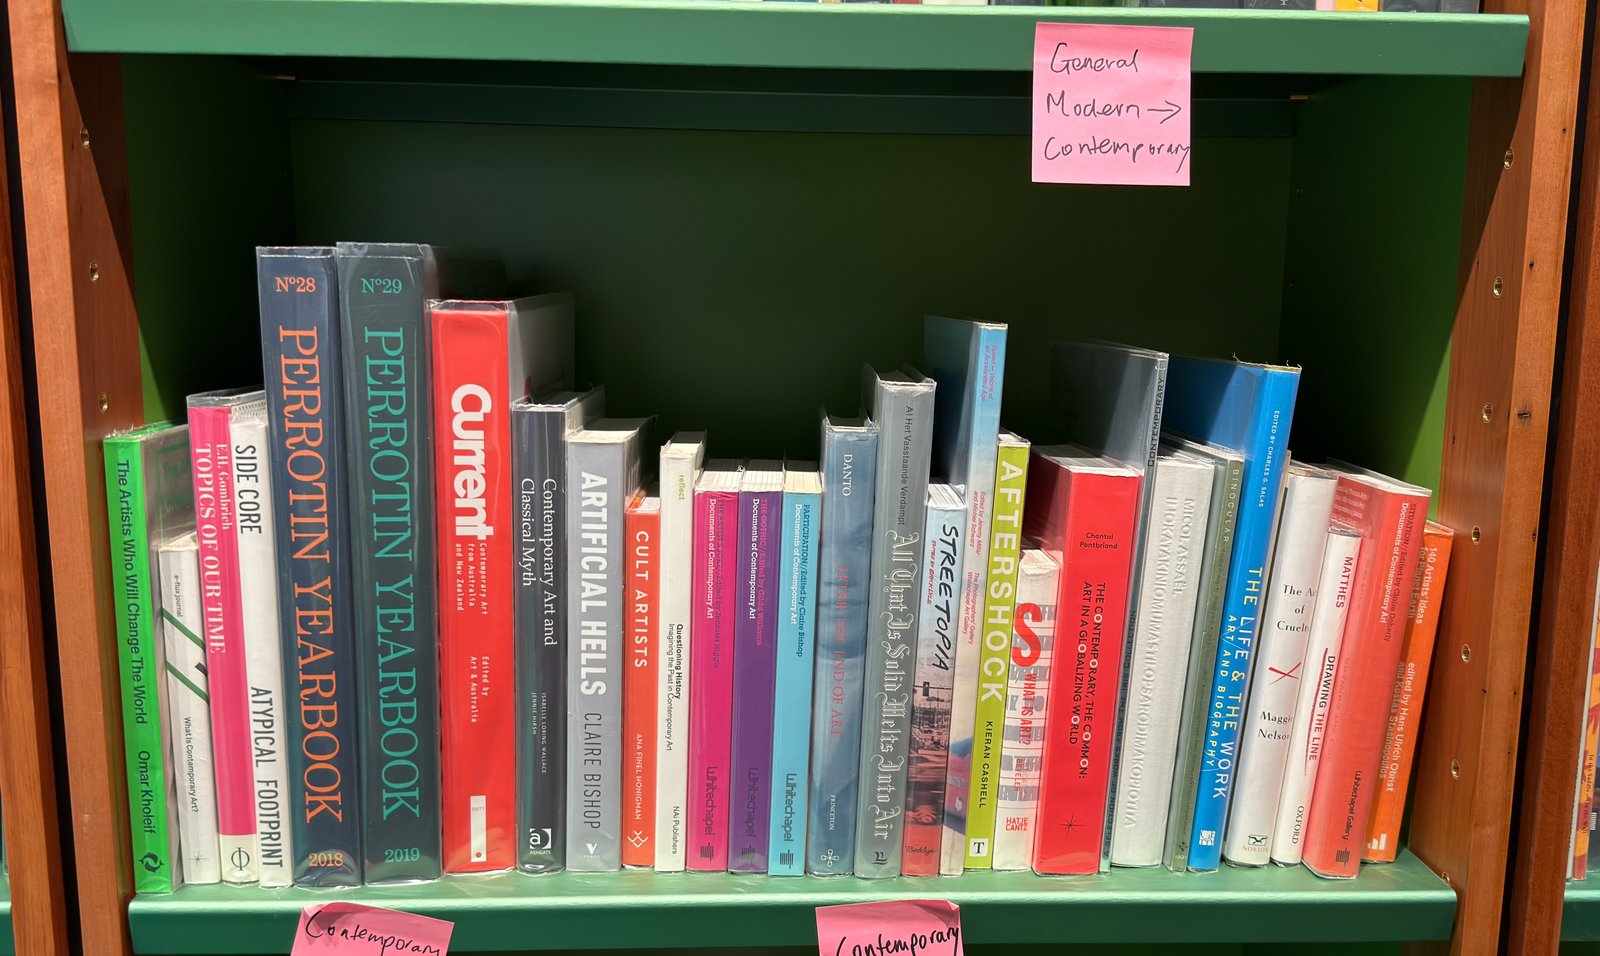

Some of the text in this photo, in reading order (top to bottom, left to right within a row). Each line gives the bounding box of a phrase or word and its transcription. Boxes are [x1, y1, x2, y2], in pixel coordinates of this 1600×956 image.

[1050, 42, 1138, 75] General
[1046, 90, 1140, 118] Modern
[1044, 136, 1190, 174] Contemporary
[1147, 377, 1164, 467] CONTEMPORARY
[1269, 436, 1277, 444] BY
[1271, 410, 1280, 433] EDITED
[216, 444, 232, 530] E.H. Gombrich
[235, 445, 262, 534] SIDE CORE
[451, 384, 493, 540] Current
[842, 454, 852, 496] DANTO
[898, 406, 913, 525] Al Het Vasstaande Verdampt
[1264, 446, 1273, 475] CHARLES
[708, 499, 717, 541] Documents
[751, 499, 759, 541] Documents
[1223, 470, 1240, 542] BINOCULAR
[1259, 486, 1267, 507] SALAS
[195, 444, 225, 653] TOPICS OF OUR TIME
[519, 478, 536, 586] Classical Myth
[540, 478, 557, 646] Contemporary Art and
[1380, 502, 1408, 623] Documents of Contemporary Art
[117, 460, 148, 724] The Artists Who Will Change The World
[174, 575, 183, 617] e-flux journal
[279, 325, 343, 823] PERROTIN YEARBOOK
[364, 326, 420, 820] PERROTIN YEARBOOK
[456, 579, 464, 611] Zealand
[468, 565, 476, 607] Australia
[479, 543, 487, 597] Contemporary
[580, 471, 608, 695] ARTIFICIAL HELLS
[634, 531, 649, 668] CULT ARTISTS
[706, 552, 715, 606] Contemporary
[749, 552, 757, 606] Contemporary
[932, 524, 959, 671] STREETOPIA
[981, 461, 1023, 702] AFTERSHOCK
[1283, 585, 1302, 596] The
[1335, 557, 1354, 608] MATTHES
[1416, 547, 1438, 624] 140 Artists' Ideas
[667, 624, 675, 656] Imagining
[674, 624, 684, 699] Questioning History
[1070, 582, 1092, 745] ART IN A GLOBALIZING WORLD
[481, 687, 489, 696] by
[868, 530, 919, 840] All That Is Solid Melts Into Air
[1021, 706, 1033, 715] IS
[1023, 674, 1036, 702] WHAT
[1079, 582, 1105, 779] THE CONTEMPORARY, THE COMMON:
[1206, 615, 1237, 767] ART AND BIOGRAPHY
[1213, 567, 1263, 798] THE LIFE & THE WORK
[1309, 656, 1336, 760] DRAWING THE LINE
[184, 717, 192, 736] What
[665, 693, 673, 739] Contemporary
[1019, 719, 1032, 745] ART?
[1386, 663, 1415, 792] edited by Hans Ulrich Obrist
[137, 751, 156, 834] Omar Kholeif
[186, 745, 197, 796] Contemporary
[251, 687, 283, 867] ATYPICAL FOOTPRINT
[583, 713, 602, 829] CLAIRE BISHOP
[979, 721, 993, 809] KIERAN CASHELL
[190, 797, 198, 812] Art?
[703, 767, 717, 835] Whitechapel
[782, 773, 797, 842] Whitechapel
[1292, 805, 1305, 844] OXFORD
[1342, 770, 1362, 840] Whitechapel Gallery
[308, 853, 344, 867] 2018
[385, 848, 420, 862] 2019
